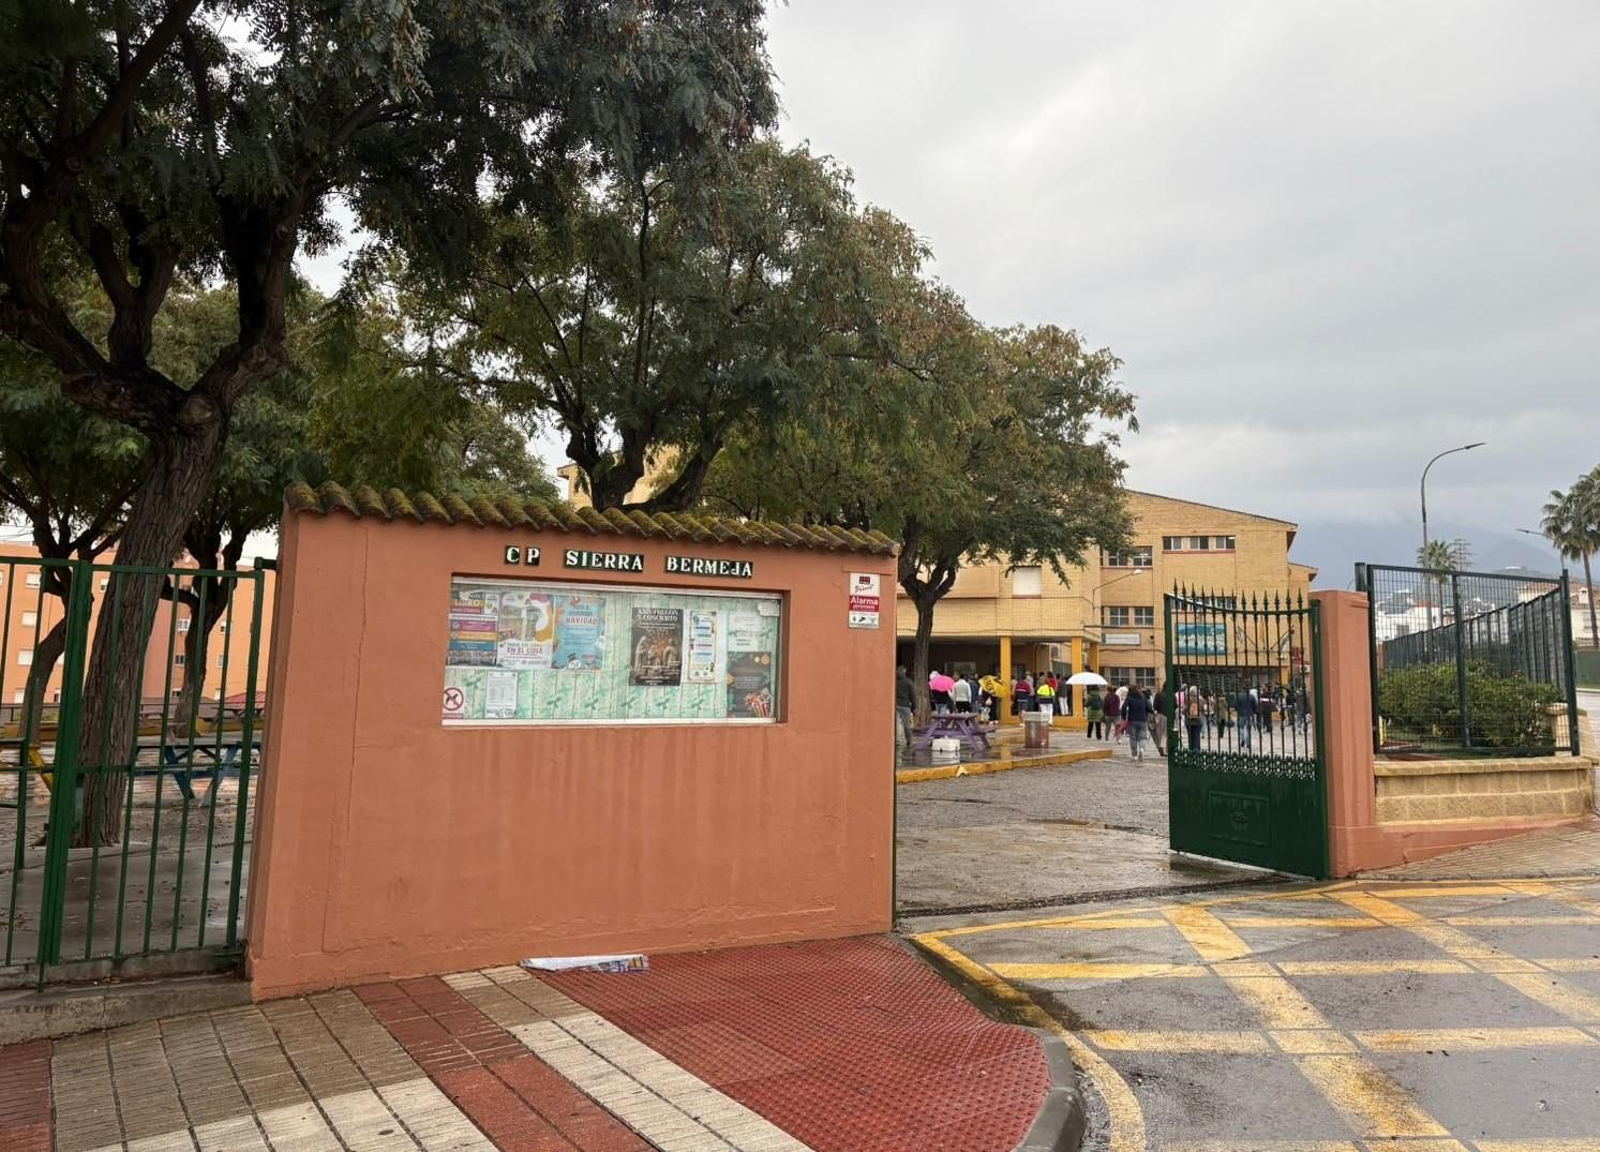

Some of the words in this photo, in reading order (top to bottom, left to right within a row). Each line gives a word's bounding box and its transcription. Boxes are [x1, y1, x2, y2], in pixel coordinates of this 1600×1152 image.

[566, 550, 643, 571] SIERRA
[666, 556, 752, 577] BERMEJA
[850, 596, 879, 605] Alarma
[565, 616, 598, 626] NAVIDAD
